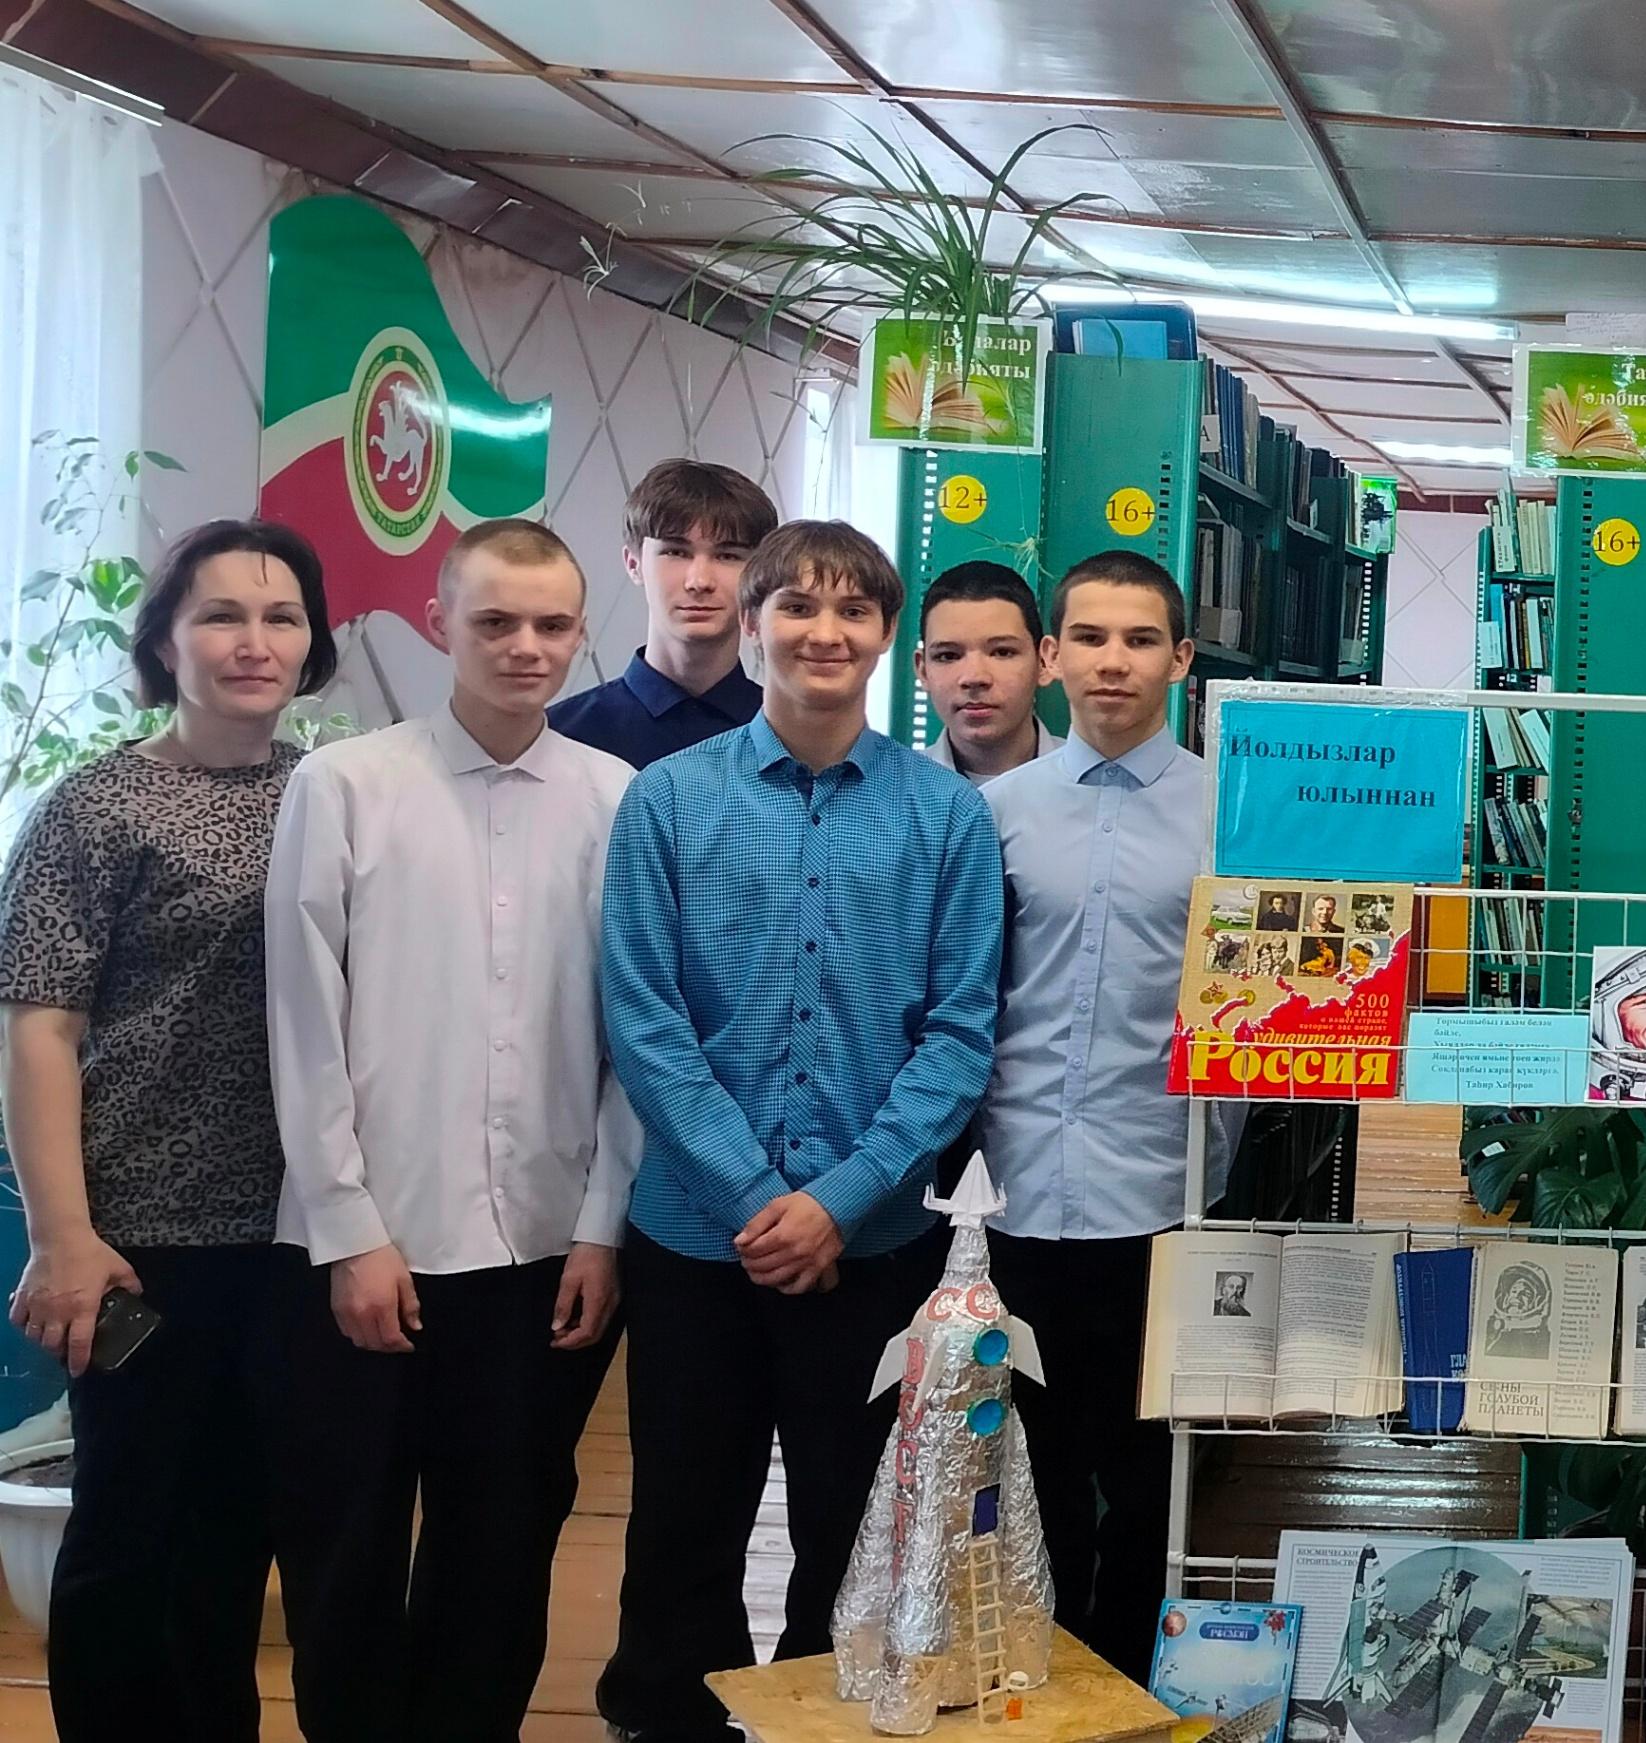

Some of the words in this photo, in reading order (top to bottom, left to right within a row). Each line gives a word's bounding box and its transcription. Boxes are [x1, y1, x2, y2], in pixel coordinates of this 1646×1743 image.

[938, 485, 988, 510] 12+
[1106, 498, 1156, 523] 16+
[1593, 530, 1641, 553] 16+
[1228, 727, 1397, 770] Йолдызлар
[1296, 782, 1436, 808] юлыннан
[1354, 992, 1390, 1009] 500
[1344, 1007, 1389, 1022] фактов
[1186, 1030, 1391, 1085] Россия
[1479, 1391, 1539, 1406] ГОЛУБОЙ
